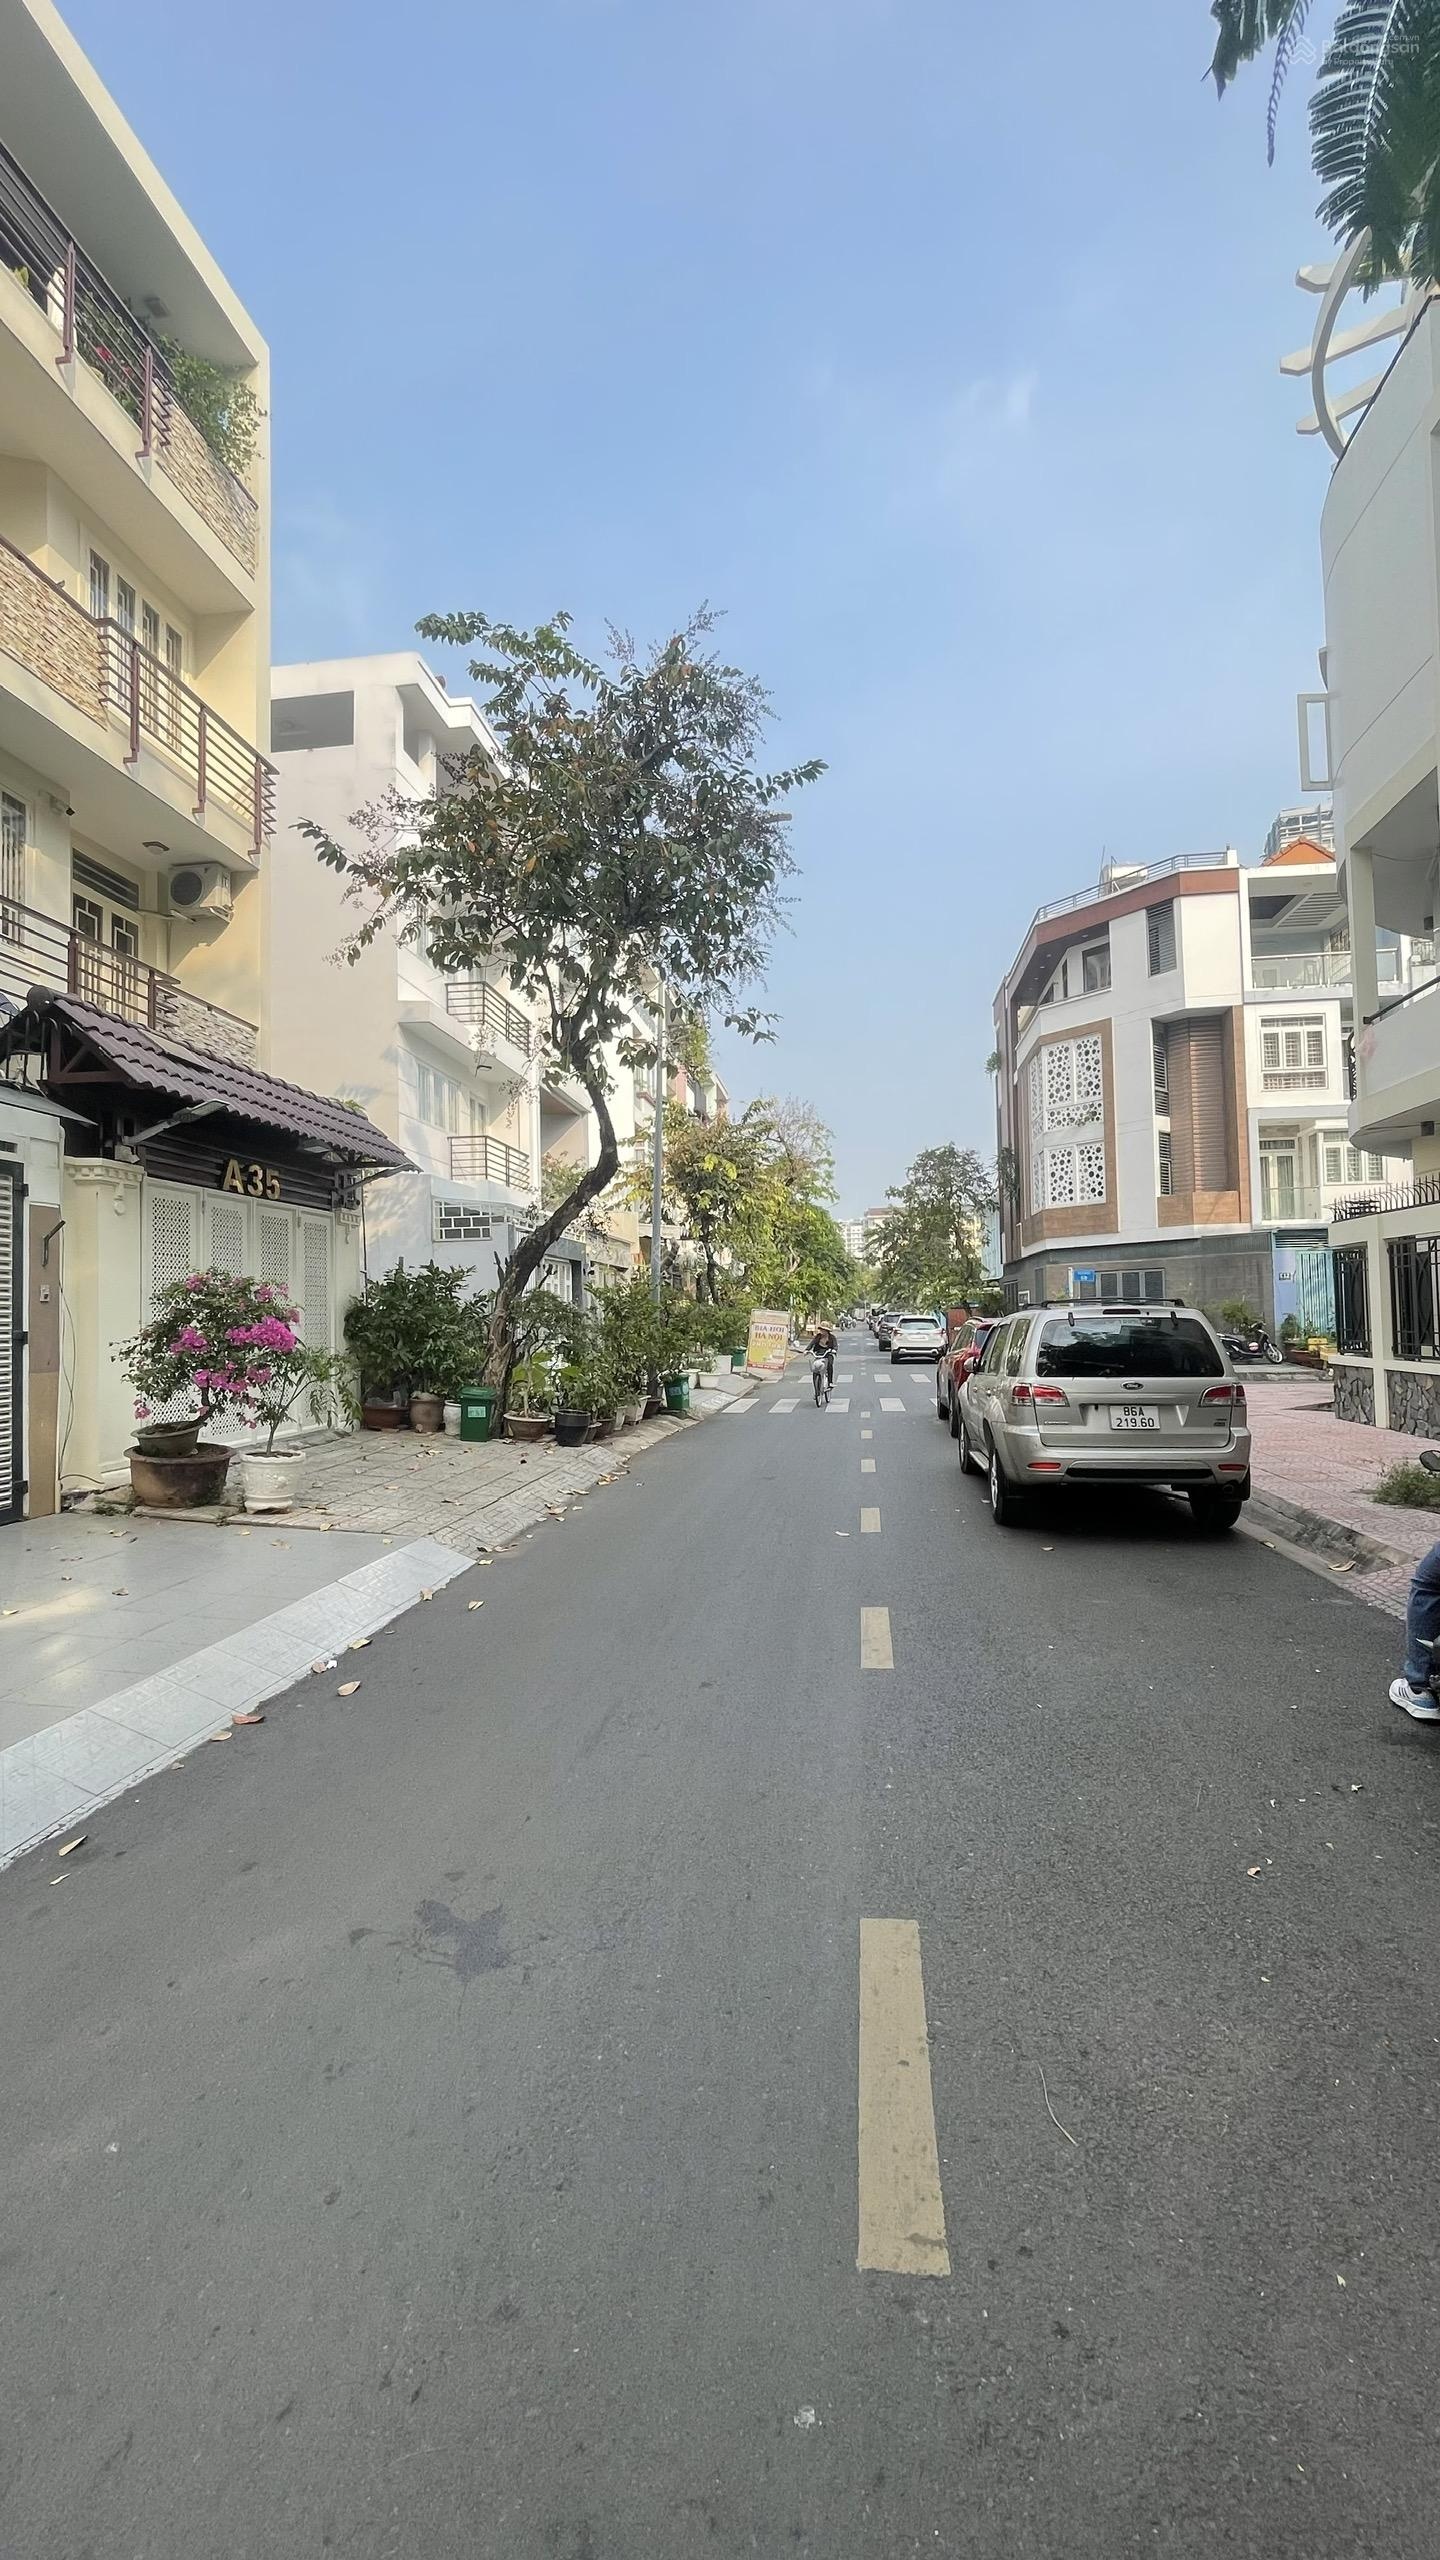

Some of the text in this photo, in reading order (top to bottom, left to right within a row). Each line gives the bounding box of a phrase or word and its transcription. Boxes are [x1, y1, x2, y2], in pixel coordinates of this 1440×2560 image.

[223, 1158, 280, 1200] A35
[1123, 1406, 1145, 1416] 86A
[1116, 1417, 1155, 1428] 219.60
